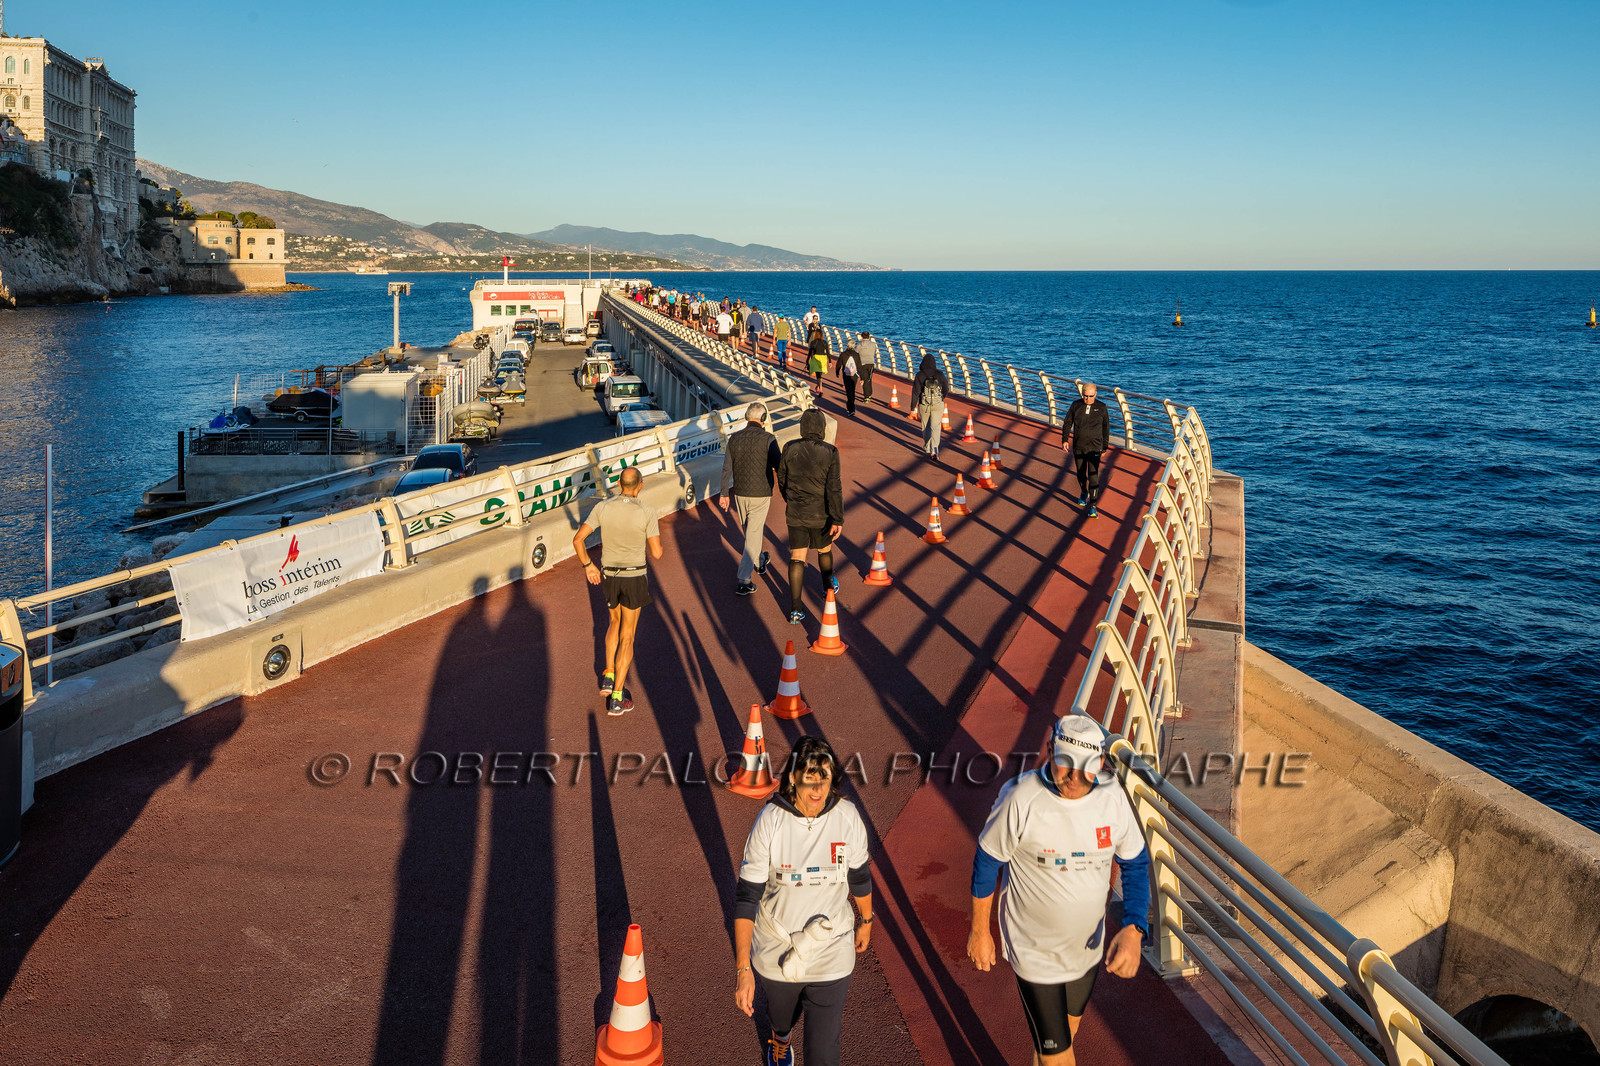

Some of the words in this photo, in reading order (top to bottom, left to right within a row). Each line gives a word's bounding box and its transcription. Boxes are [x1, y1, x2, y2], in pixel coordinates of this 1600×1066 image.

[676, 438, 721, 462] Dietsm
[241, 577, 277, 599] boss
[278, 557, 342, 586] intérim
[247, 604, 258, 614] La
[259, 590, 290, 608] Gestion
[293, 584, 309, 596] des
[313, 575, 340, 589] Talents
